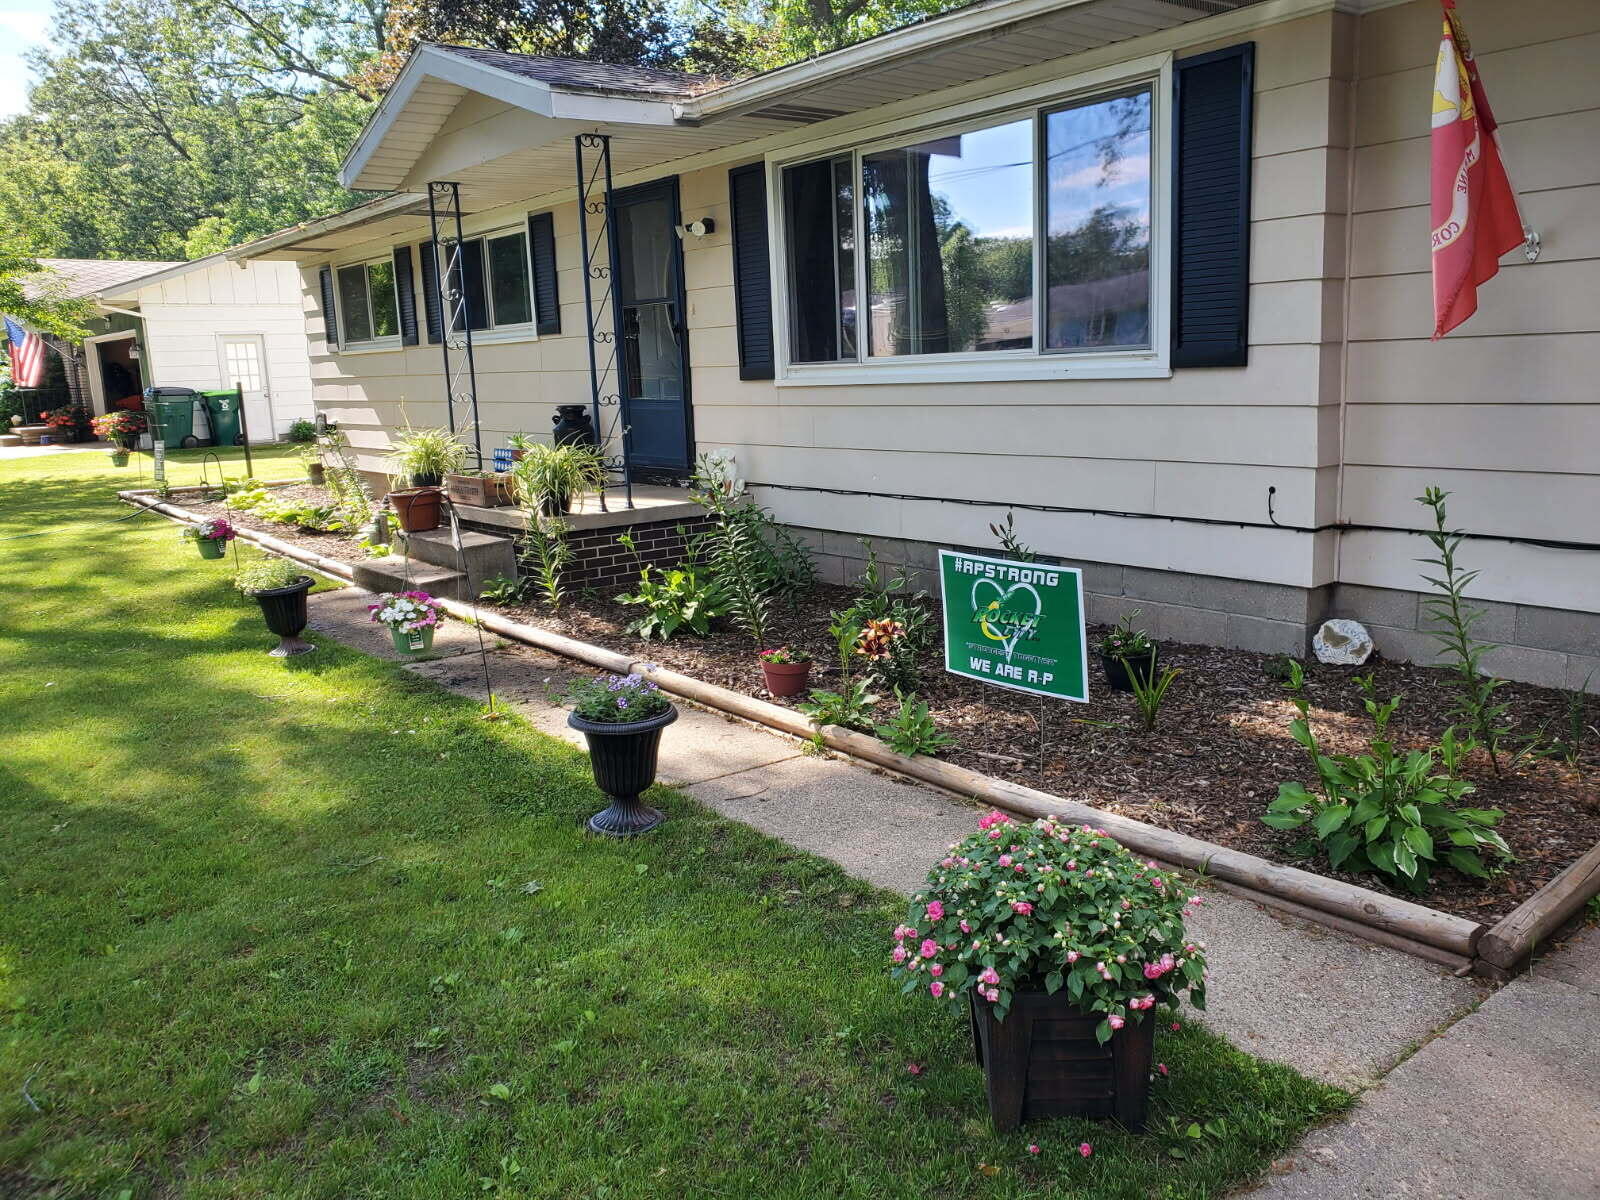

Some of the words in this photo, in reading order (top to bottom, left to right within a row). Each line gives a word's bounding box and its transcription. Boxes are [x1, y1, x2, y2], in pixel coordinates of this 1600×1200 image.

[971, 607, 1047, 628] ROCKET
[970, 656, 991, 673] WE
[995, 663, 1023, 680] ARE
[1027, 669, 1054, 685] R-P
